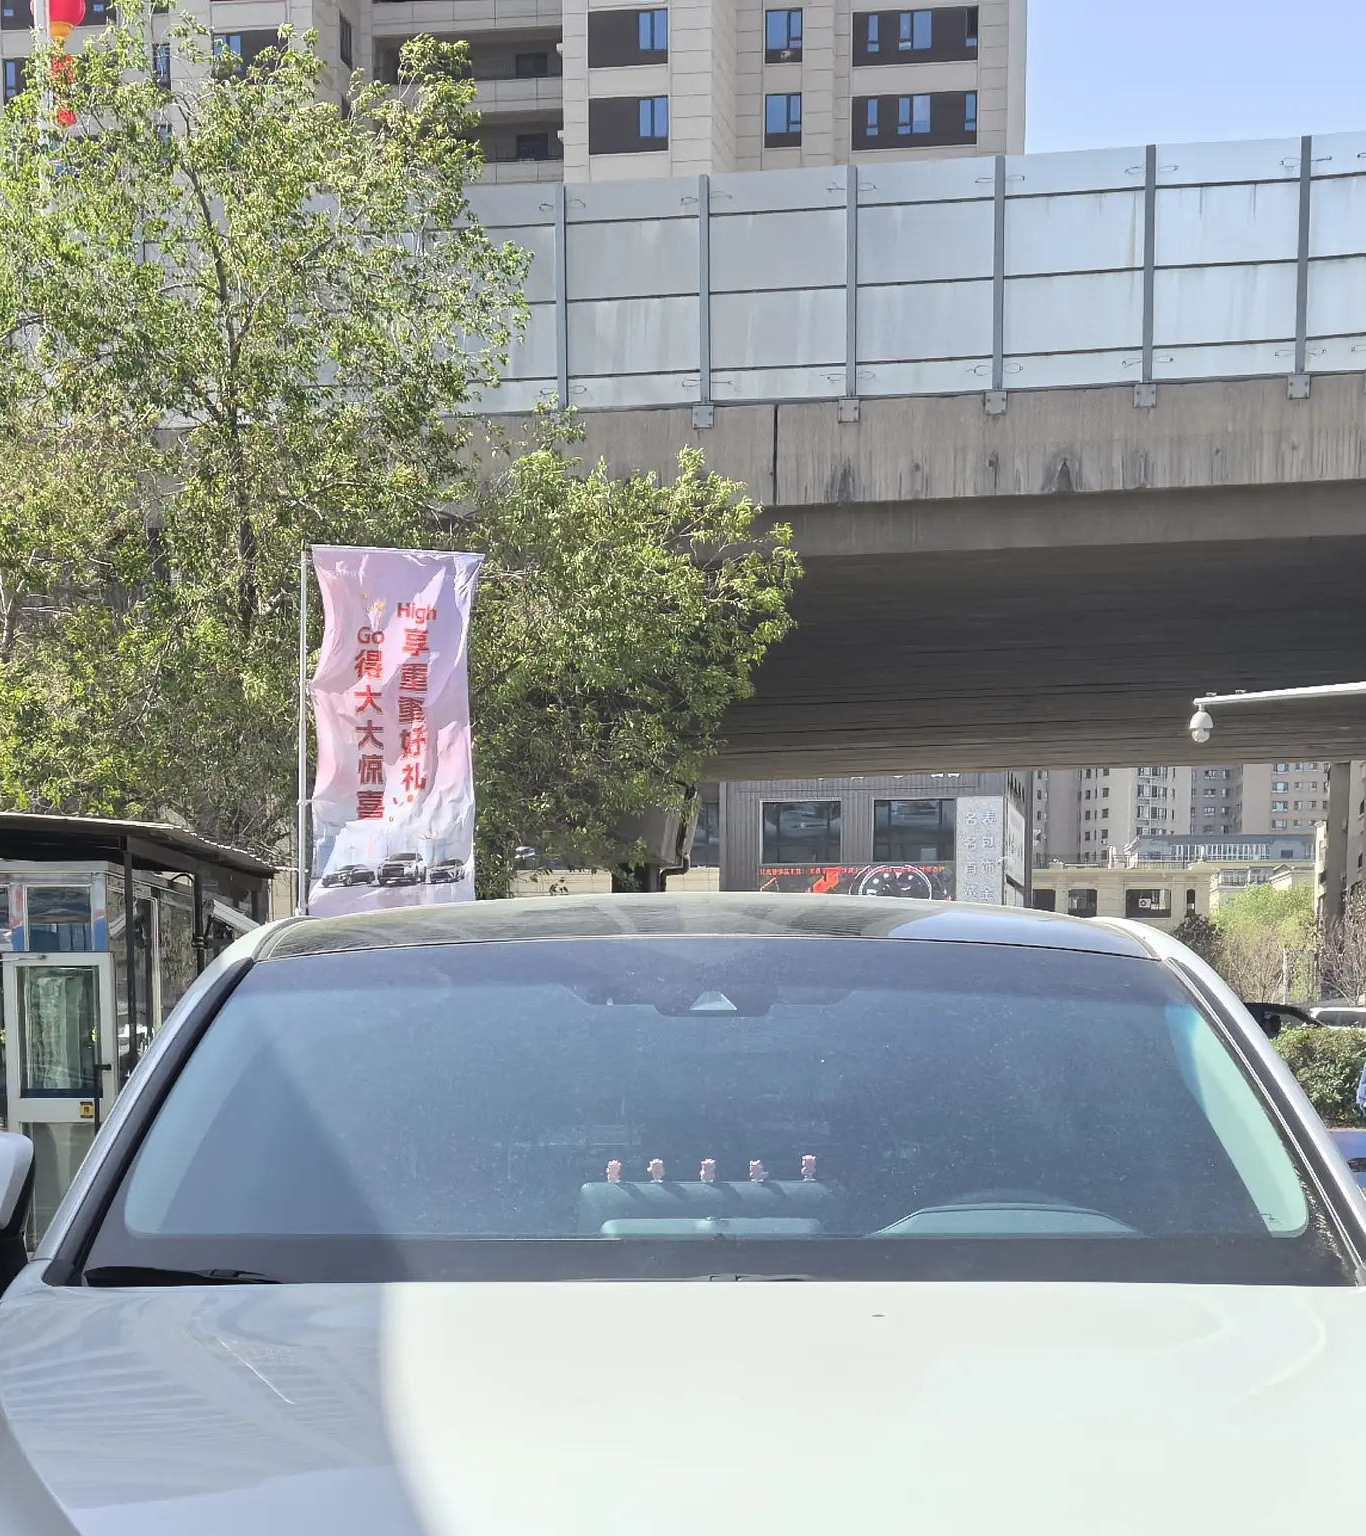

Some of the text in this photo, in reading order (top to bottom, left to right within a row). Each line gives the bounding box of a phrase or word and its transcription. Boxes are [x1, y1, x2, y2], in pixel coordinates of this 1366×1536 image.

[357, 626, 385, 644] Go
[397, 602, 437, 624] High
[355, 648, 384, 821] 得大大惊喜
[398, 628, 430, 792] 享重重好礼
